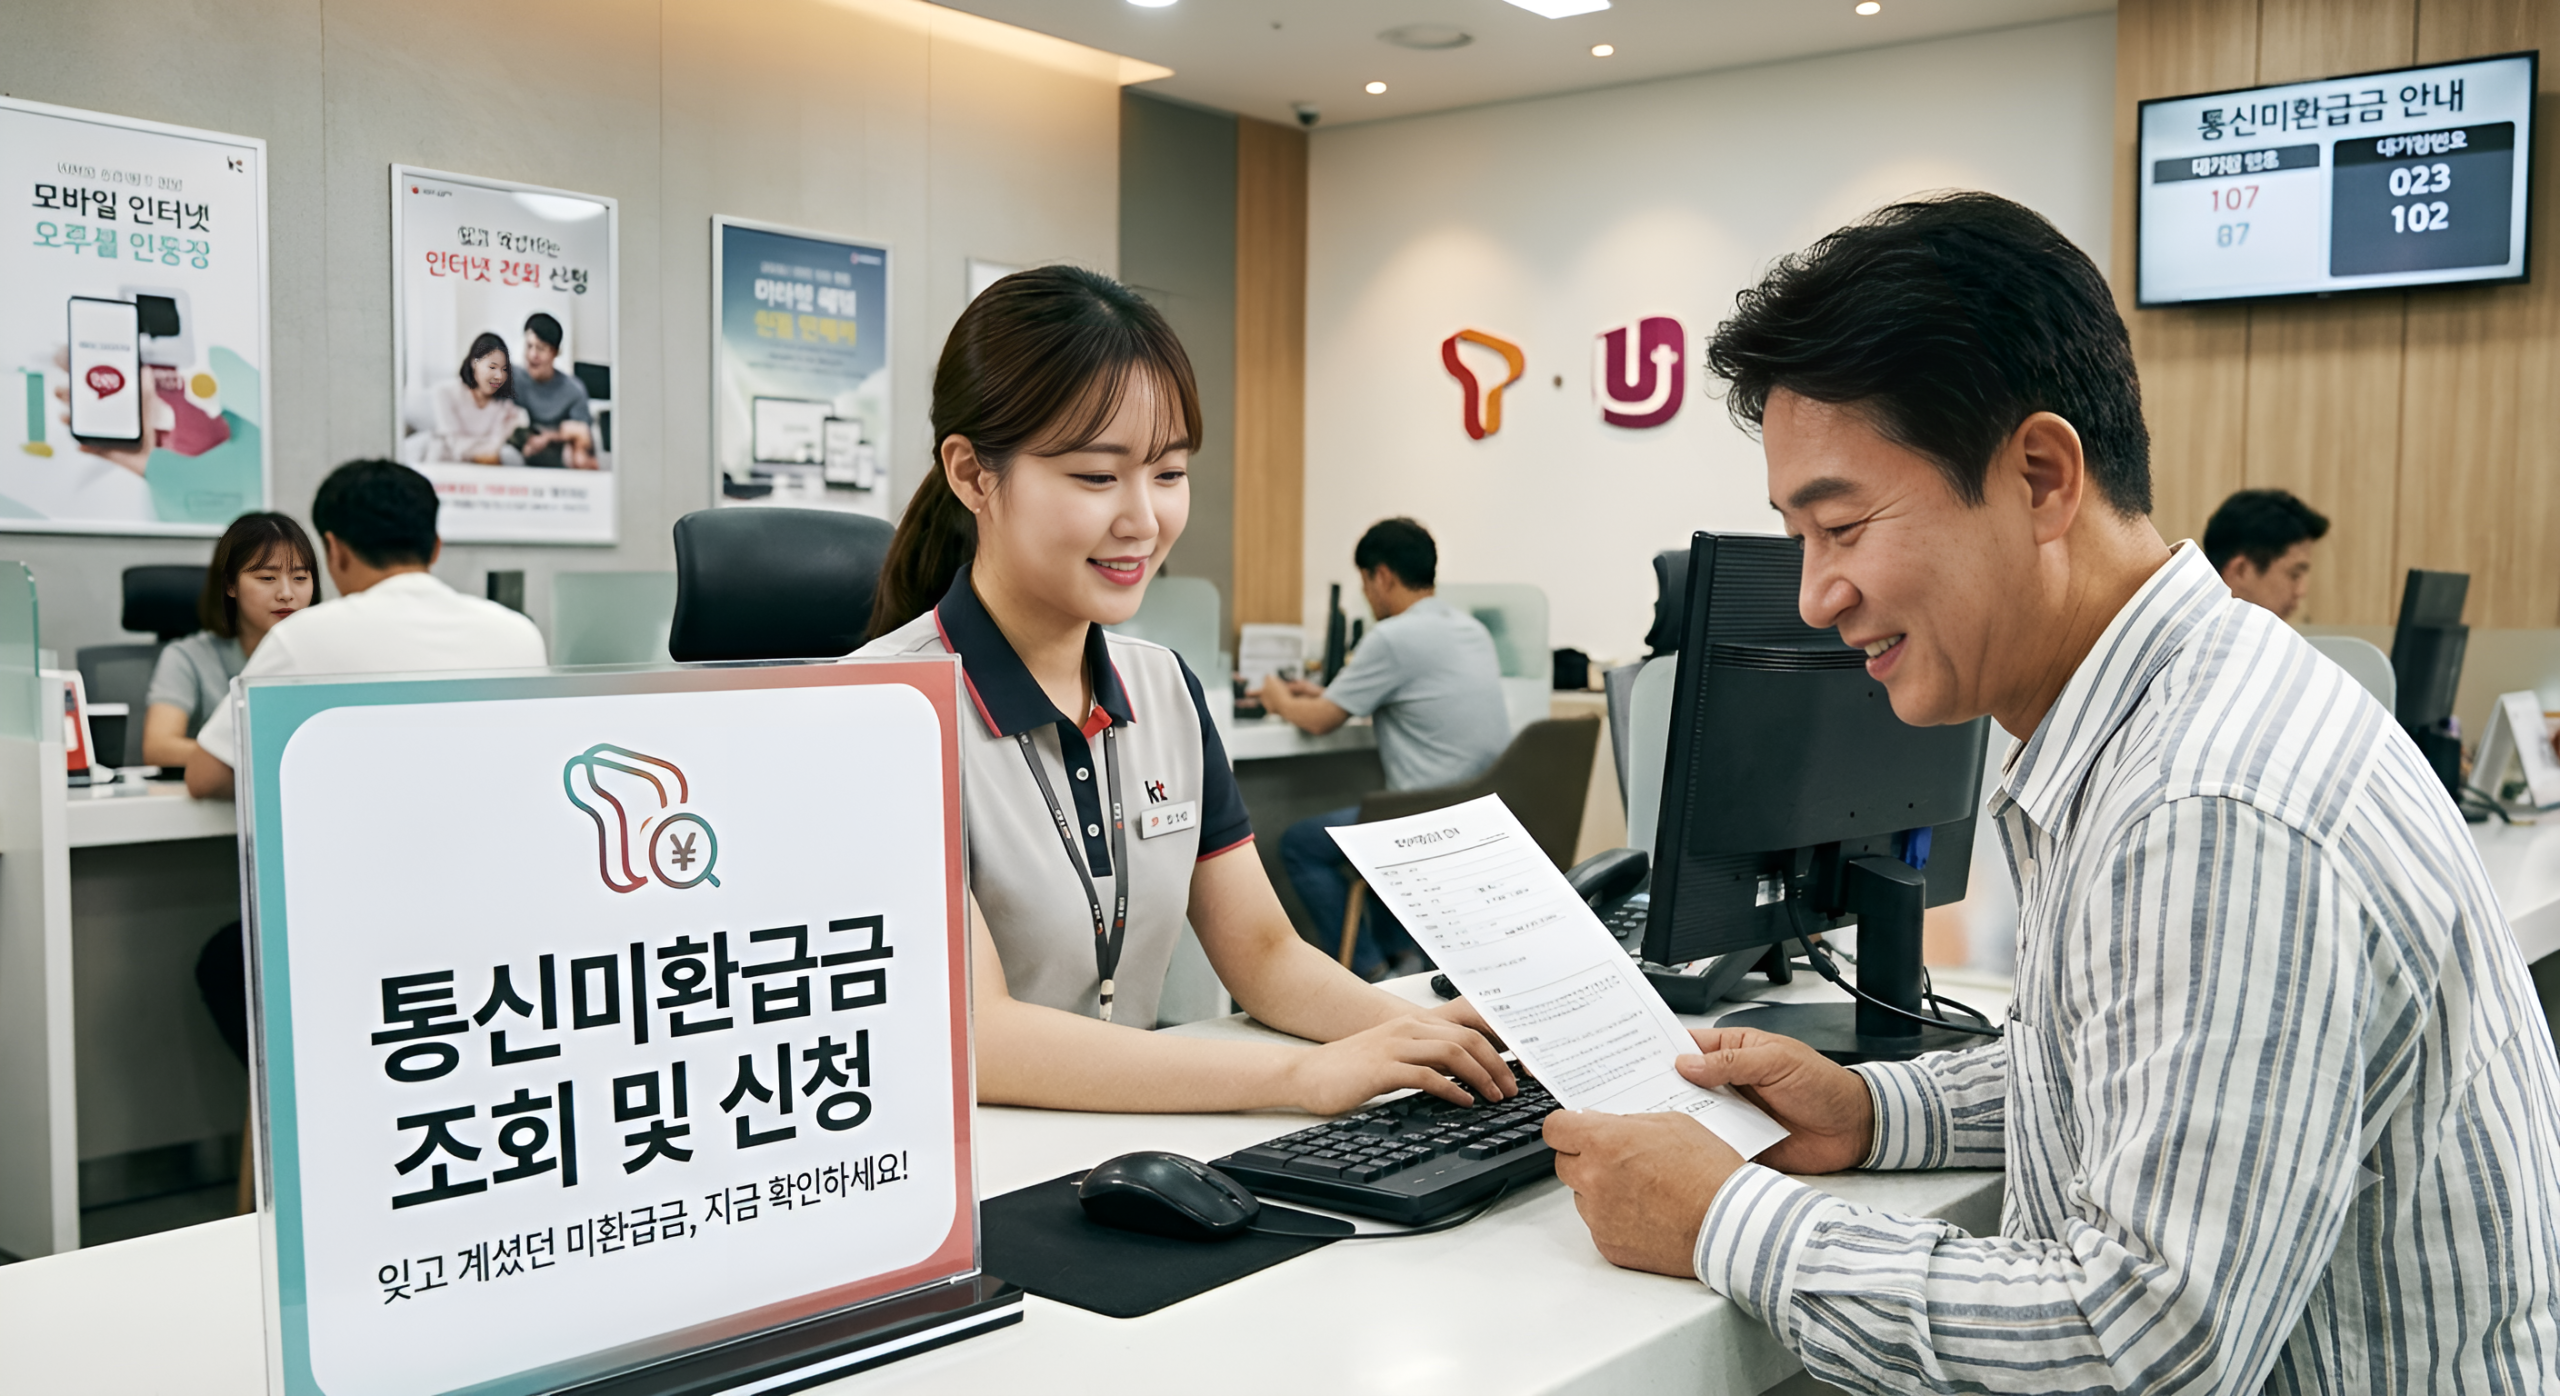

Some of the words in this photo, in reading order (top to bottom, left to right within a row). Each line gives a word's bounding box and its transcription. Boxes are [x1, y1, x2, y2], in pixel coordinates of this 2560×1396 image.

[2197, 89, 2388, 141] 통신미환급금
[2399, 78, 2465, 118] 안내
[2211, 185, 2260, 212] 107
[2389, 163, 2451, 197] 023
[32, 183, 117, 221] 모바일
[128, 195, 210, 233] 인터넷
[2391, 201, 2449, 233] 102
[426, 250, 492, 283] 인터넷
[1144, 780, 1168, 804] kt
[370, 914, 894, 1083] 통신미환급금
[391, 1081, 578, 1210] 조회
[612, 1061, 694, 1175] 및
[719, 1029, 872, 1150] 신청
[377, 1255, 449, 1305] 잊고
[457, 1226, 556, 1282] 계셨던
[567, 1199, 698, 1258] 미환급금,
[704, 1182, 762, 1226] 지금
[768, 1150, 909, 1212] 확인하세요!
